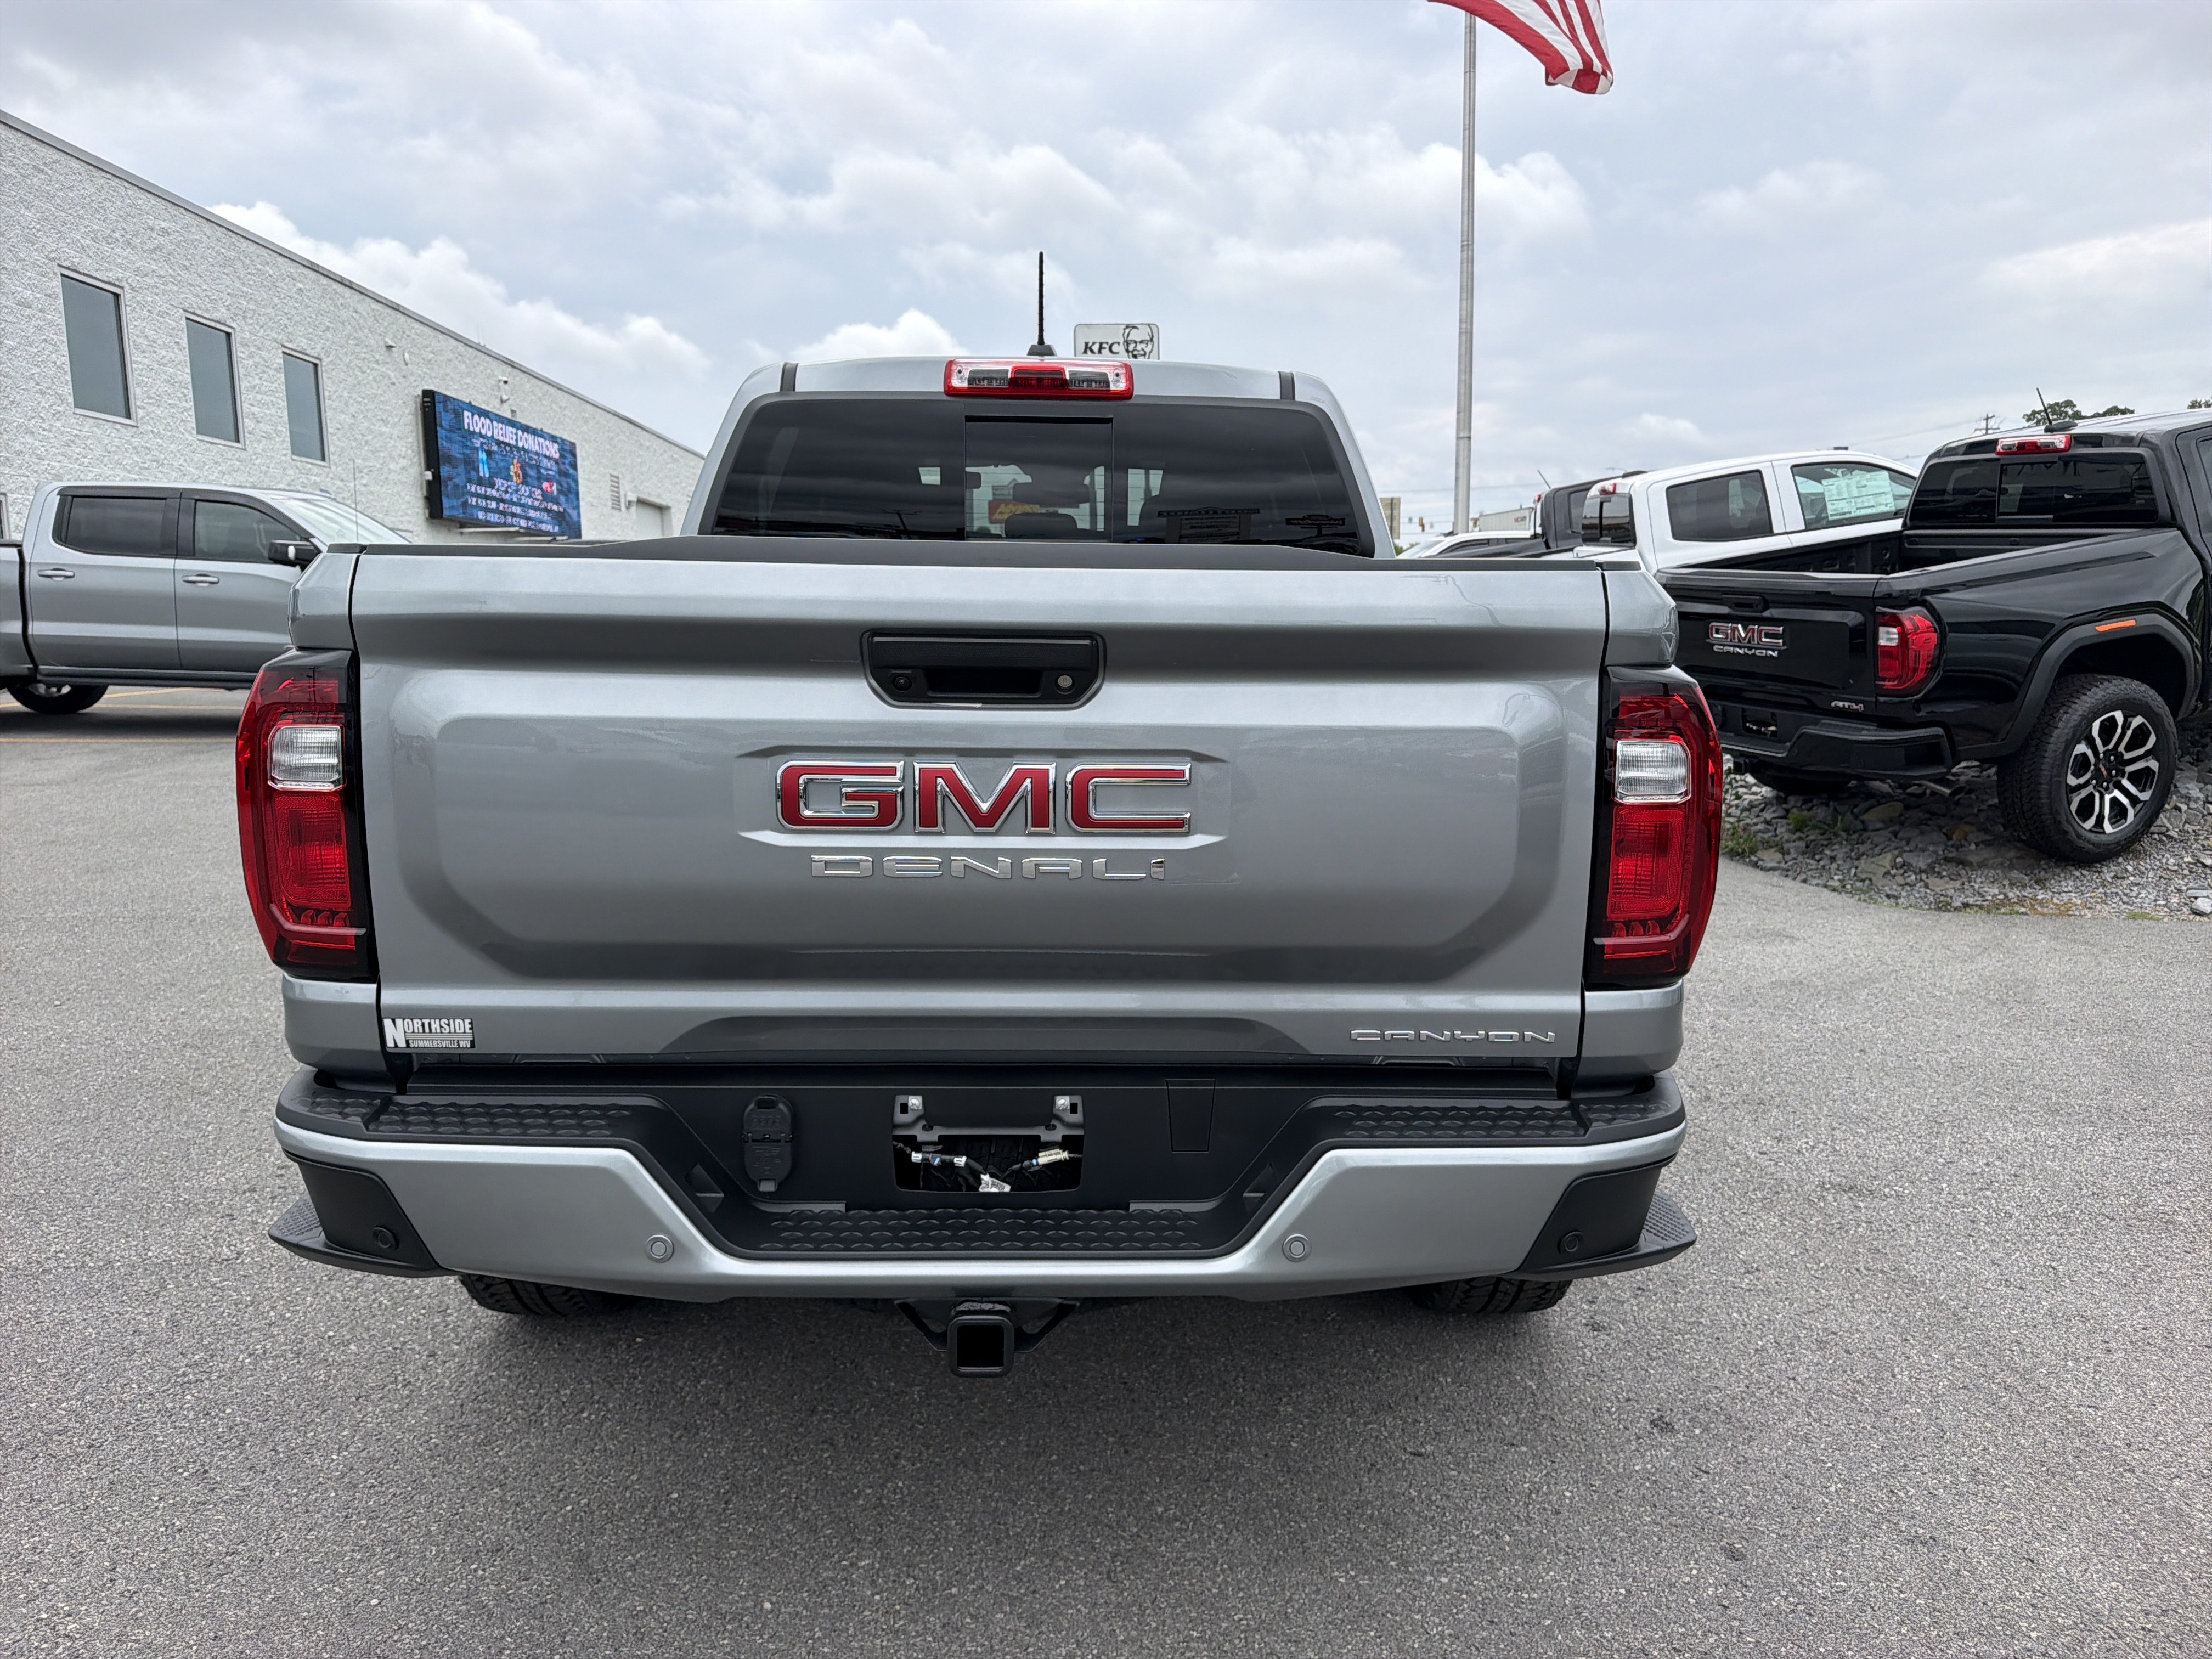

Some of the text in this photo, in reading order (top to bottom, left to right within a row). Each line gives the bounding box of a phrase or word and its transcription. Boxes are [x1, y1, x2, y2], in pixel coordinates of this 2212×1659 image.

[1082, 341, 1120, 354] KFC
[464, 410, 493, 437] FLOOD
[493, 421, 517, 445] RELIEF
[517, 430, 560, 459] DONATIONS
[1709, 622, 1784, 646] GMC
[1713, 645, 1778, 657] CANYON
[1831, 701, 1864, 712] AT4
[776, 760, 1192, 835] GMC
[811, 855, 1165, 879] DENALI
[383, 1018, 472, 1047] NORTHSIDE
[1350, 1029, 1556, 1043] CANYON
[409, 1040, 458, 1048] SUMMERSVILLE
